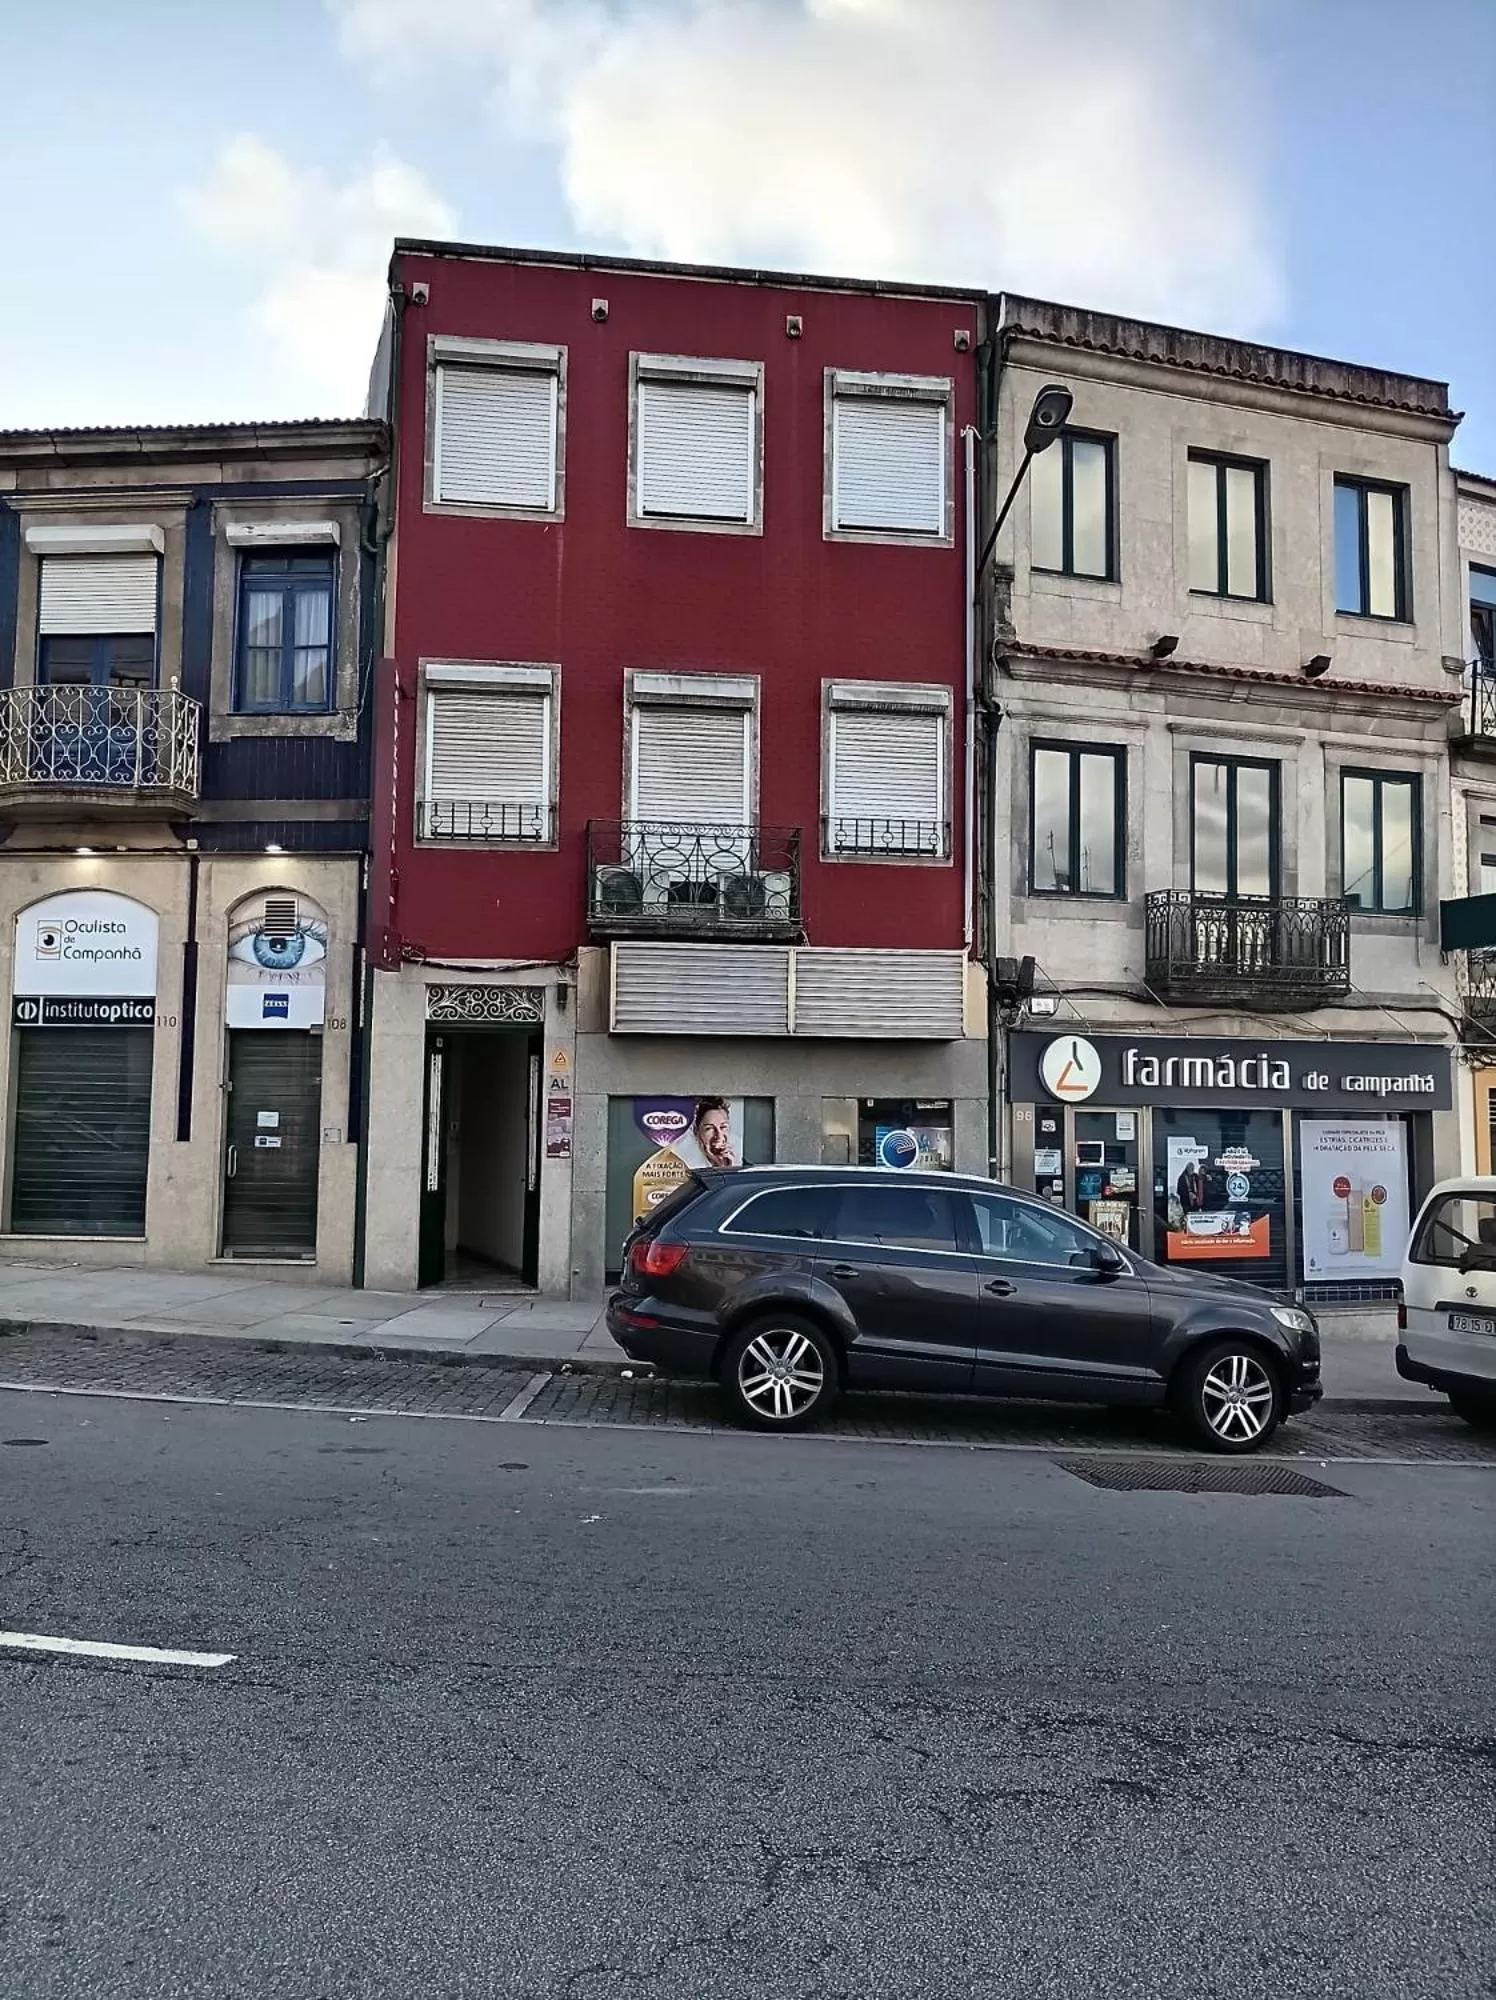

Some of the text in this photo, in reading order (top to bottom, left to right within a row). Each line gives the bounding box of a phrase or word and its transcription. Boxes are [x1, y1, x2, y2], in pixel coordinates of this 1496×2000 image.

[65, 919, 126, 934] Oculista
[64, 935, 76, 944] de
[63, 946, 142, 963] Campanhã
[264, 1000, 288, 1008] ZEISS
[45, 1001, 153, 1023] institutoptico
[157, 1016, 177, 1028] 110
[327, 1018, 347, 1030] 108
[1122, 1048, 1290, 1089] farmácia
[1303, 1071, 1329, 1091] de
[550, 1078, 569, 1089] AL
[646, 1115, 684, 1126] COREGA
[1016, 1110, 1032, 1121] 96
[652, 1160, 683, 1170] FIXAÇÃO
[642, 1170, 661, 1178] MAIS
